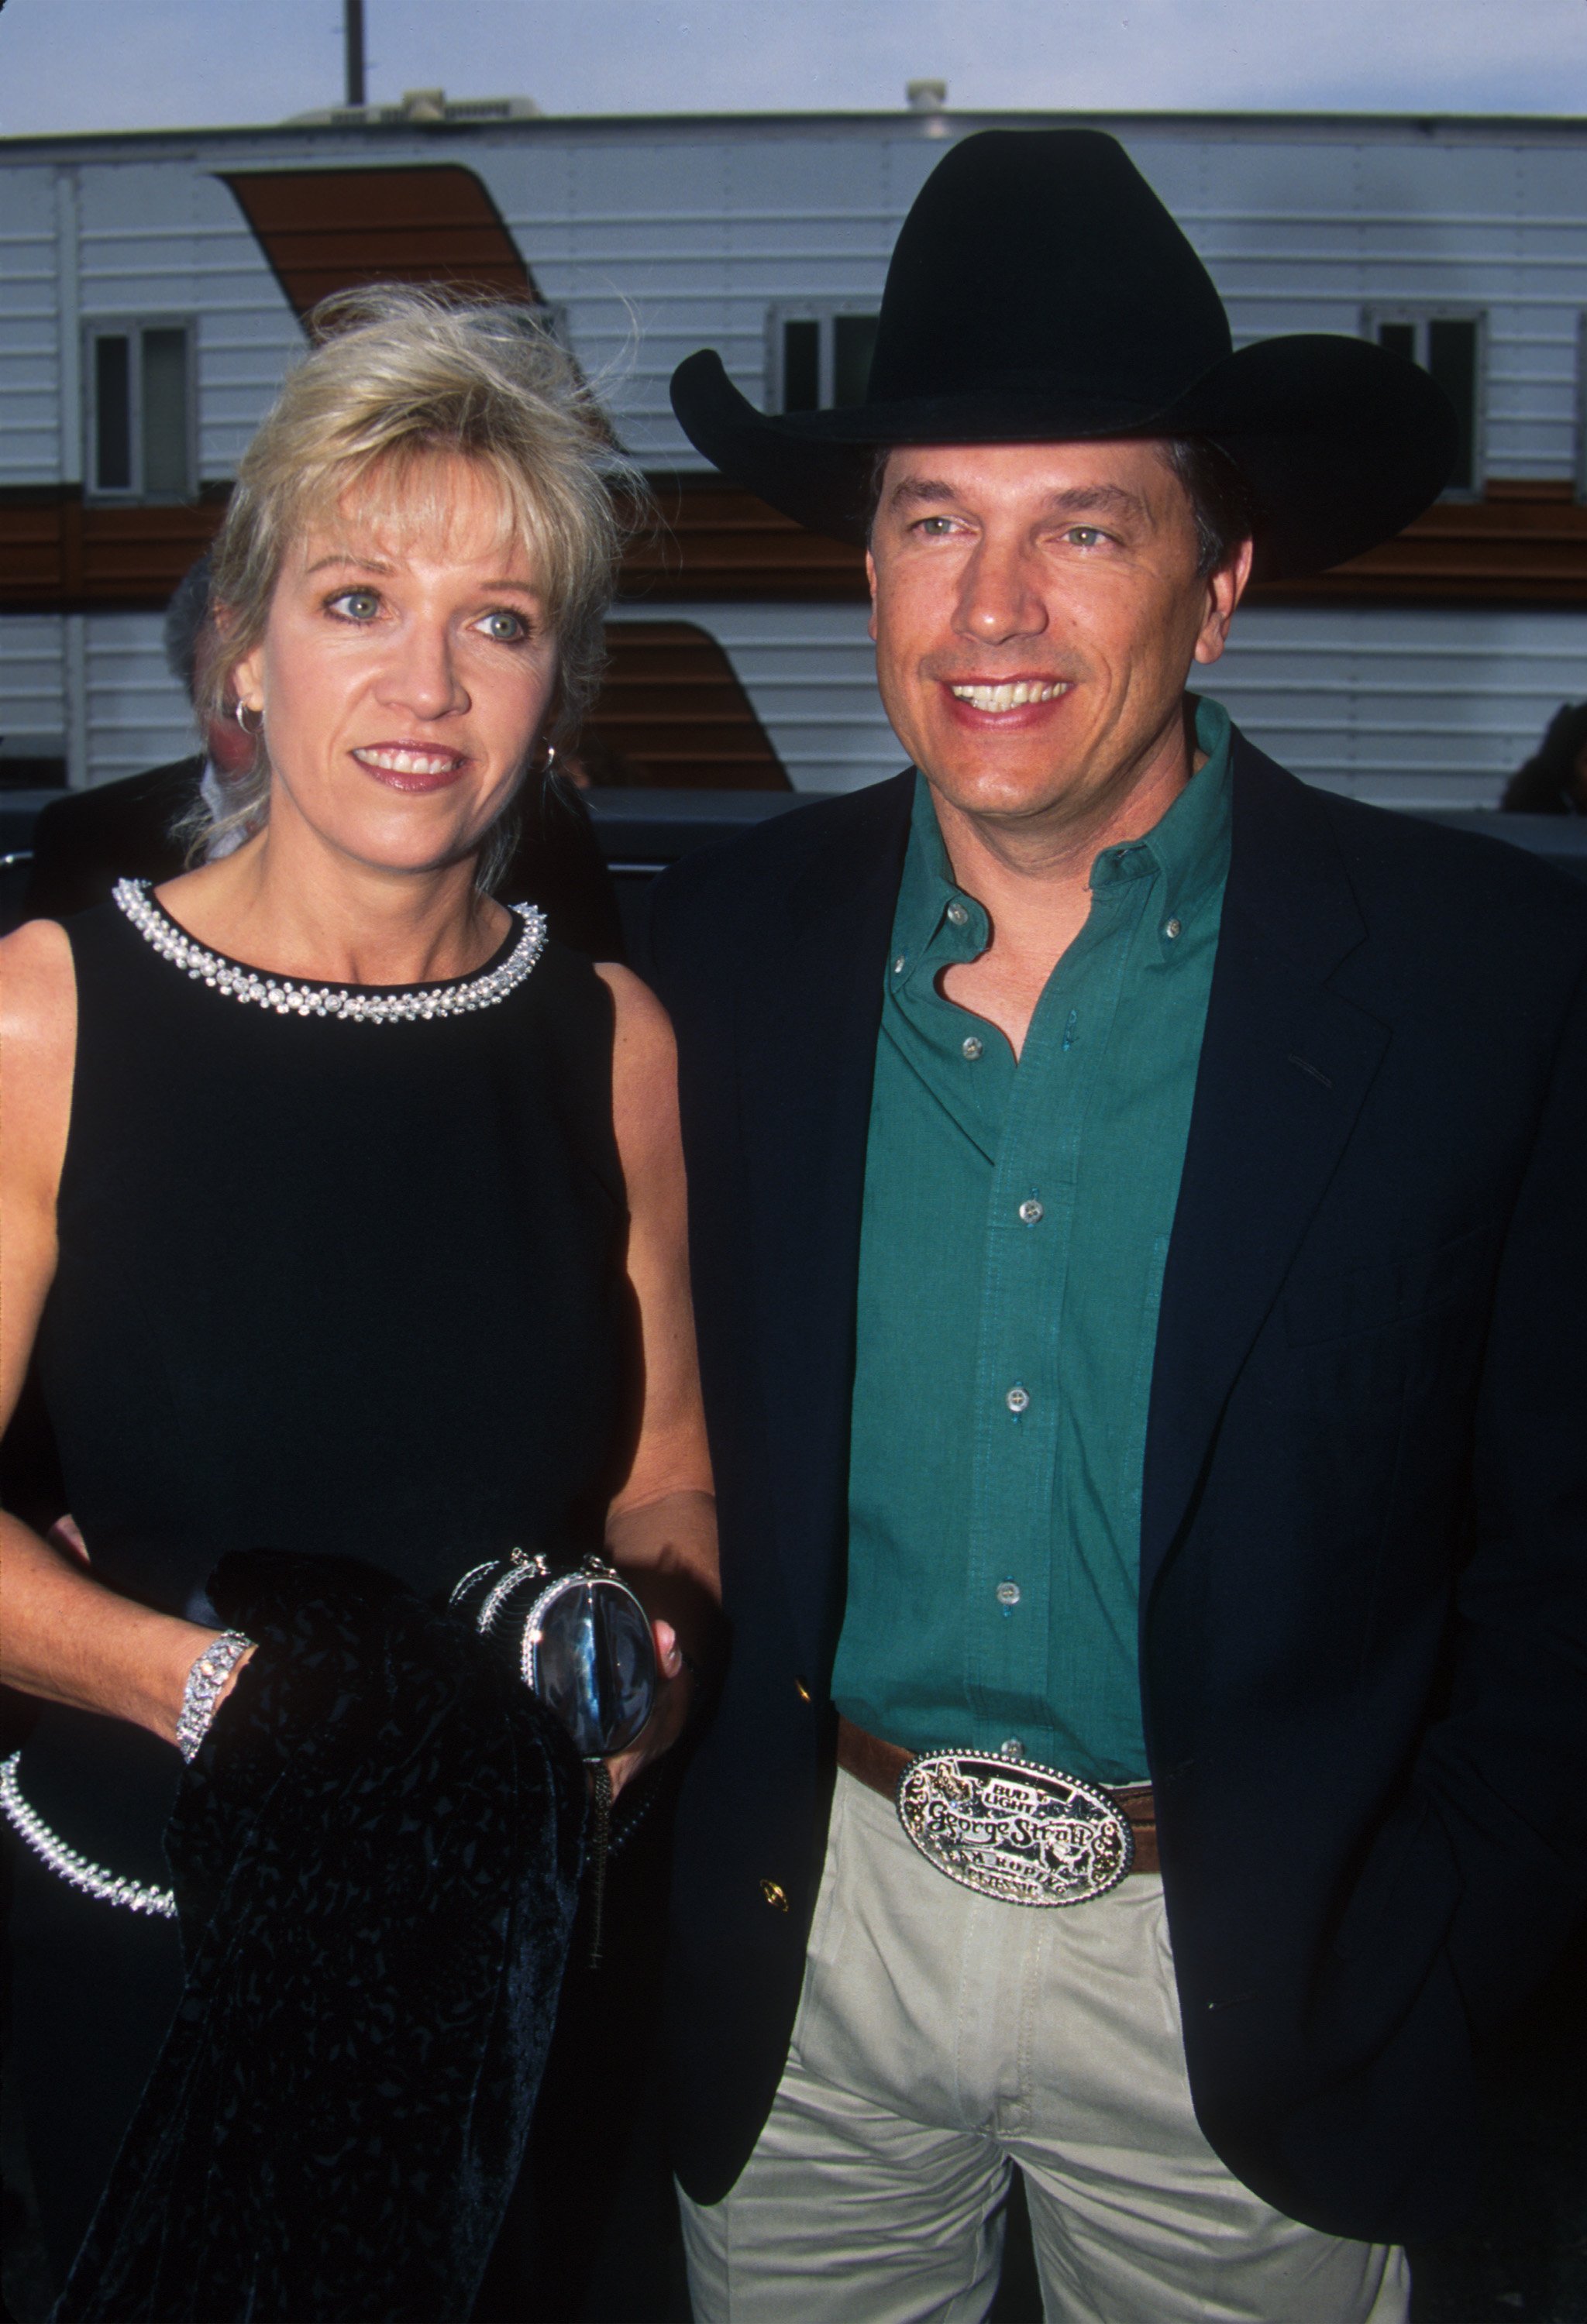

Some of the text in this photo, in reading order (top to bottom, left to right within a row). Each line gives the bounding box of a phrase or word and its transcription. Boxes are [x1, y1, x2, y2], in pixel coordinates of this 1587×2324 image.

[984, 1793, 1035, 1814] LIGHT
[992, 1783, 1030, 1801] BUD
[928, 1800, 1093, 1846] George Strait
[996, 1856, 1067, 1896] ROPING
